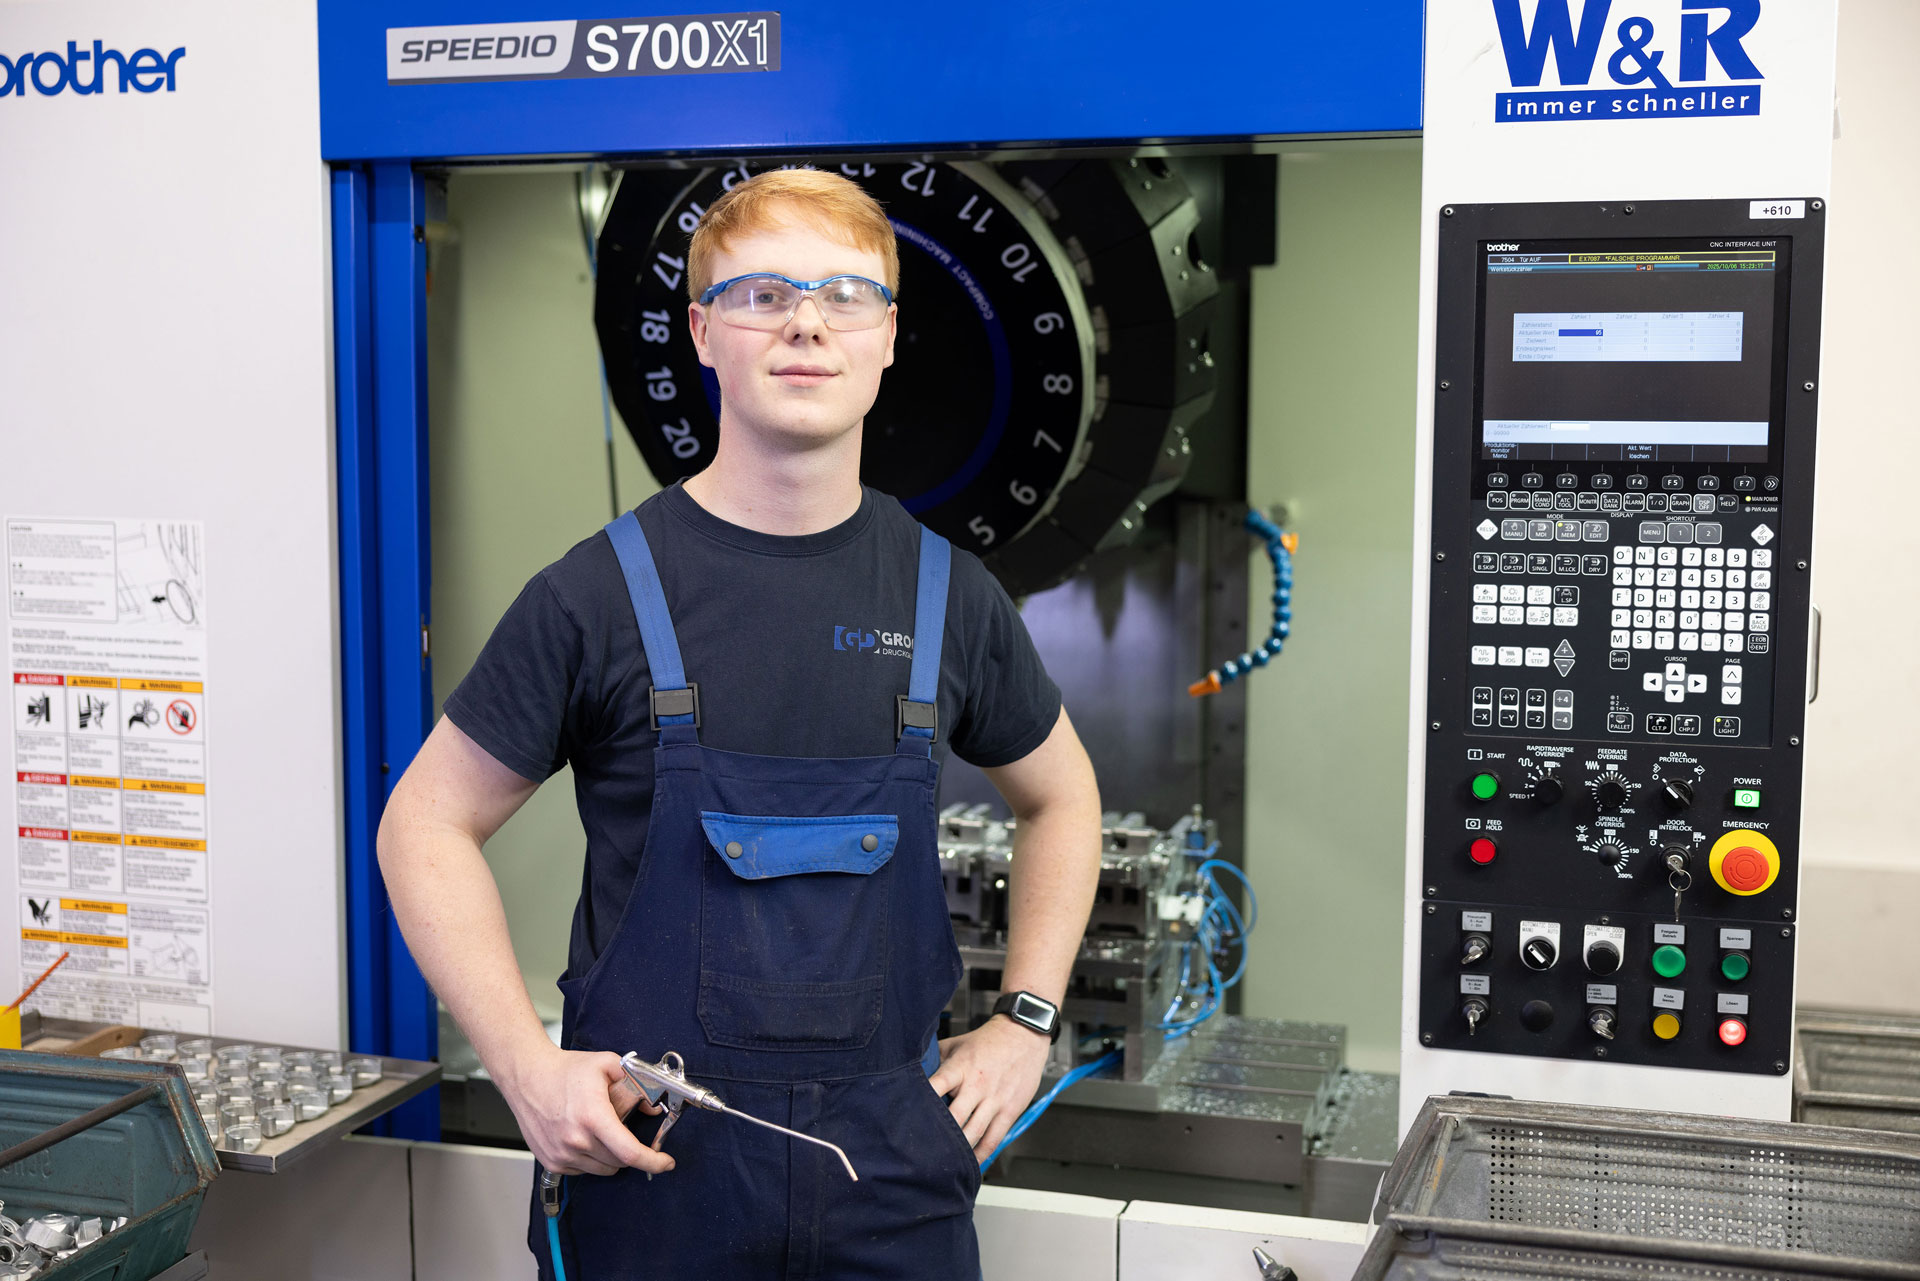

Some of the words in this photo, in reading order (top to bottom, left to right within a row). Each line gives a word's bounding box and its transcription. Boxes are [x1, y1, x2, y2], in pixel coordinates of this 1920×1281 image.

[400, 34, 558, 64] SPEEDIO
[585, 19, 769, 74] S700X1
[1491, 0, 1765, 88] W&R
[1506, 99, 1596, 116] immer
[1612, 91, 1750, 113] schneller
[957, 195, 994, 234] 11
[1762, 205, 1791, 216] +610
[1487, 243, 1520, 251] brother
[1001, 242, 1039, 284] 10
[652, 252, 686, 291] 17
[641, 310, 670, 344] 18
[645, 366, 676, 401] 19
[1043, 374, 1073, 395] 8
[661, 417, 701, 460] 20
[1033, 430, 1062, 454] 7
[968, 514, 996, 545] 5
[1638, 552, 1646, 560] N
[1661, 552, 1669, 561] G
[1689, 553, 1695, 561] 7
[1711, 553, 1717, 562] 8
[1733, 554, 1740, 562] 9
[1616, 572, 1623, 580] X
[1638, 572, 1645, 581] Y
[1661, 573, 1667, 582] Z
[1688, 573, 1694, 582] 4
[1710, 574, 1716, 582] 5
[1733, 574, 1739, 583] 6
[1616, 593, 1621, 601] F
[1637, 594, 1645, 602] D
[1659, 594, 1667, 603] H
[1688, 595, 1692, 603] 1
[1709, 596, 1716, 604] 2
[1732, 596, 1738, 605] 3
[1616, 614, 1622, 622] P
[1636, 615, 1645, 623] Q
[1659, 615, 1666, 624] R
[881, 632, 914, 649] GRO
[1613, 635, 1622, 643] M
[1636, 635, 1643, 644] S
[1658, 636, 1665, 645] T
[1527, 745, 1574, 753] RAPIDTRAVERSE
[1733, 777, 1762, 785] POWER
[1659, 824, 1692, 832] INTERLOCK
[1722, 820, 1770, 829] EMERGENCY
